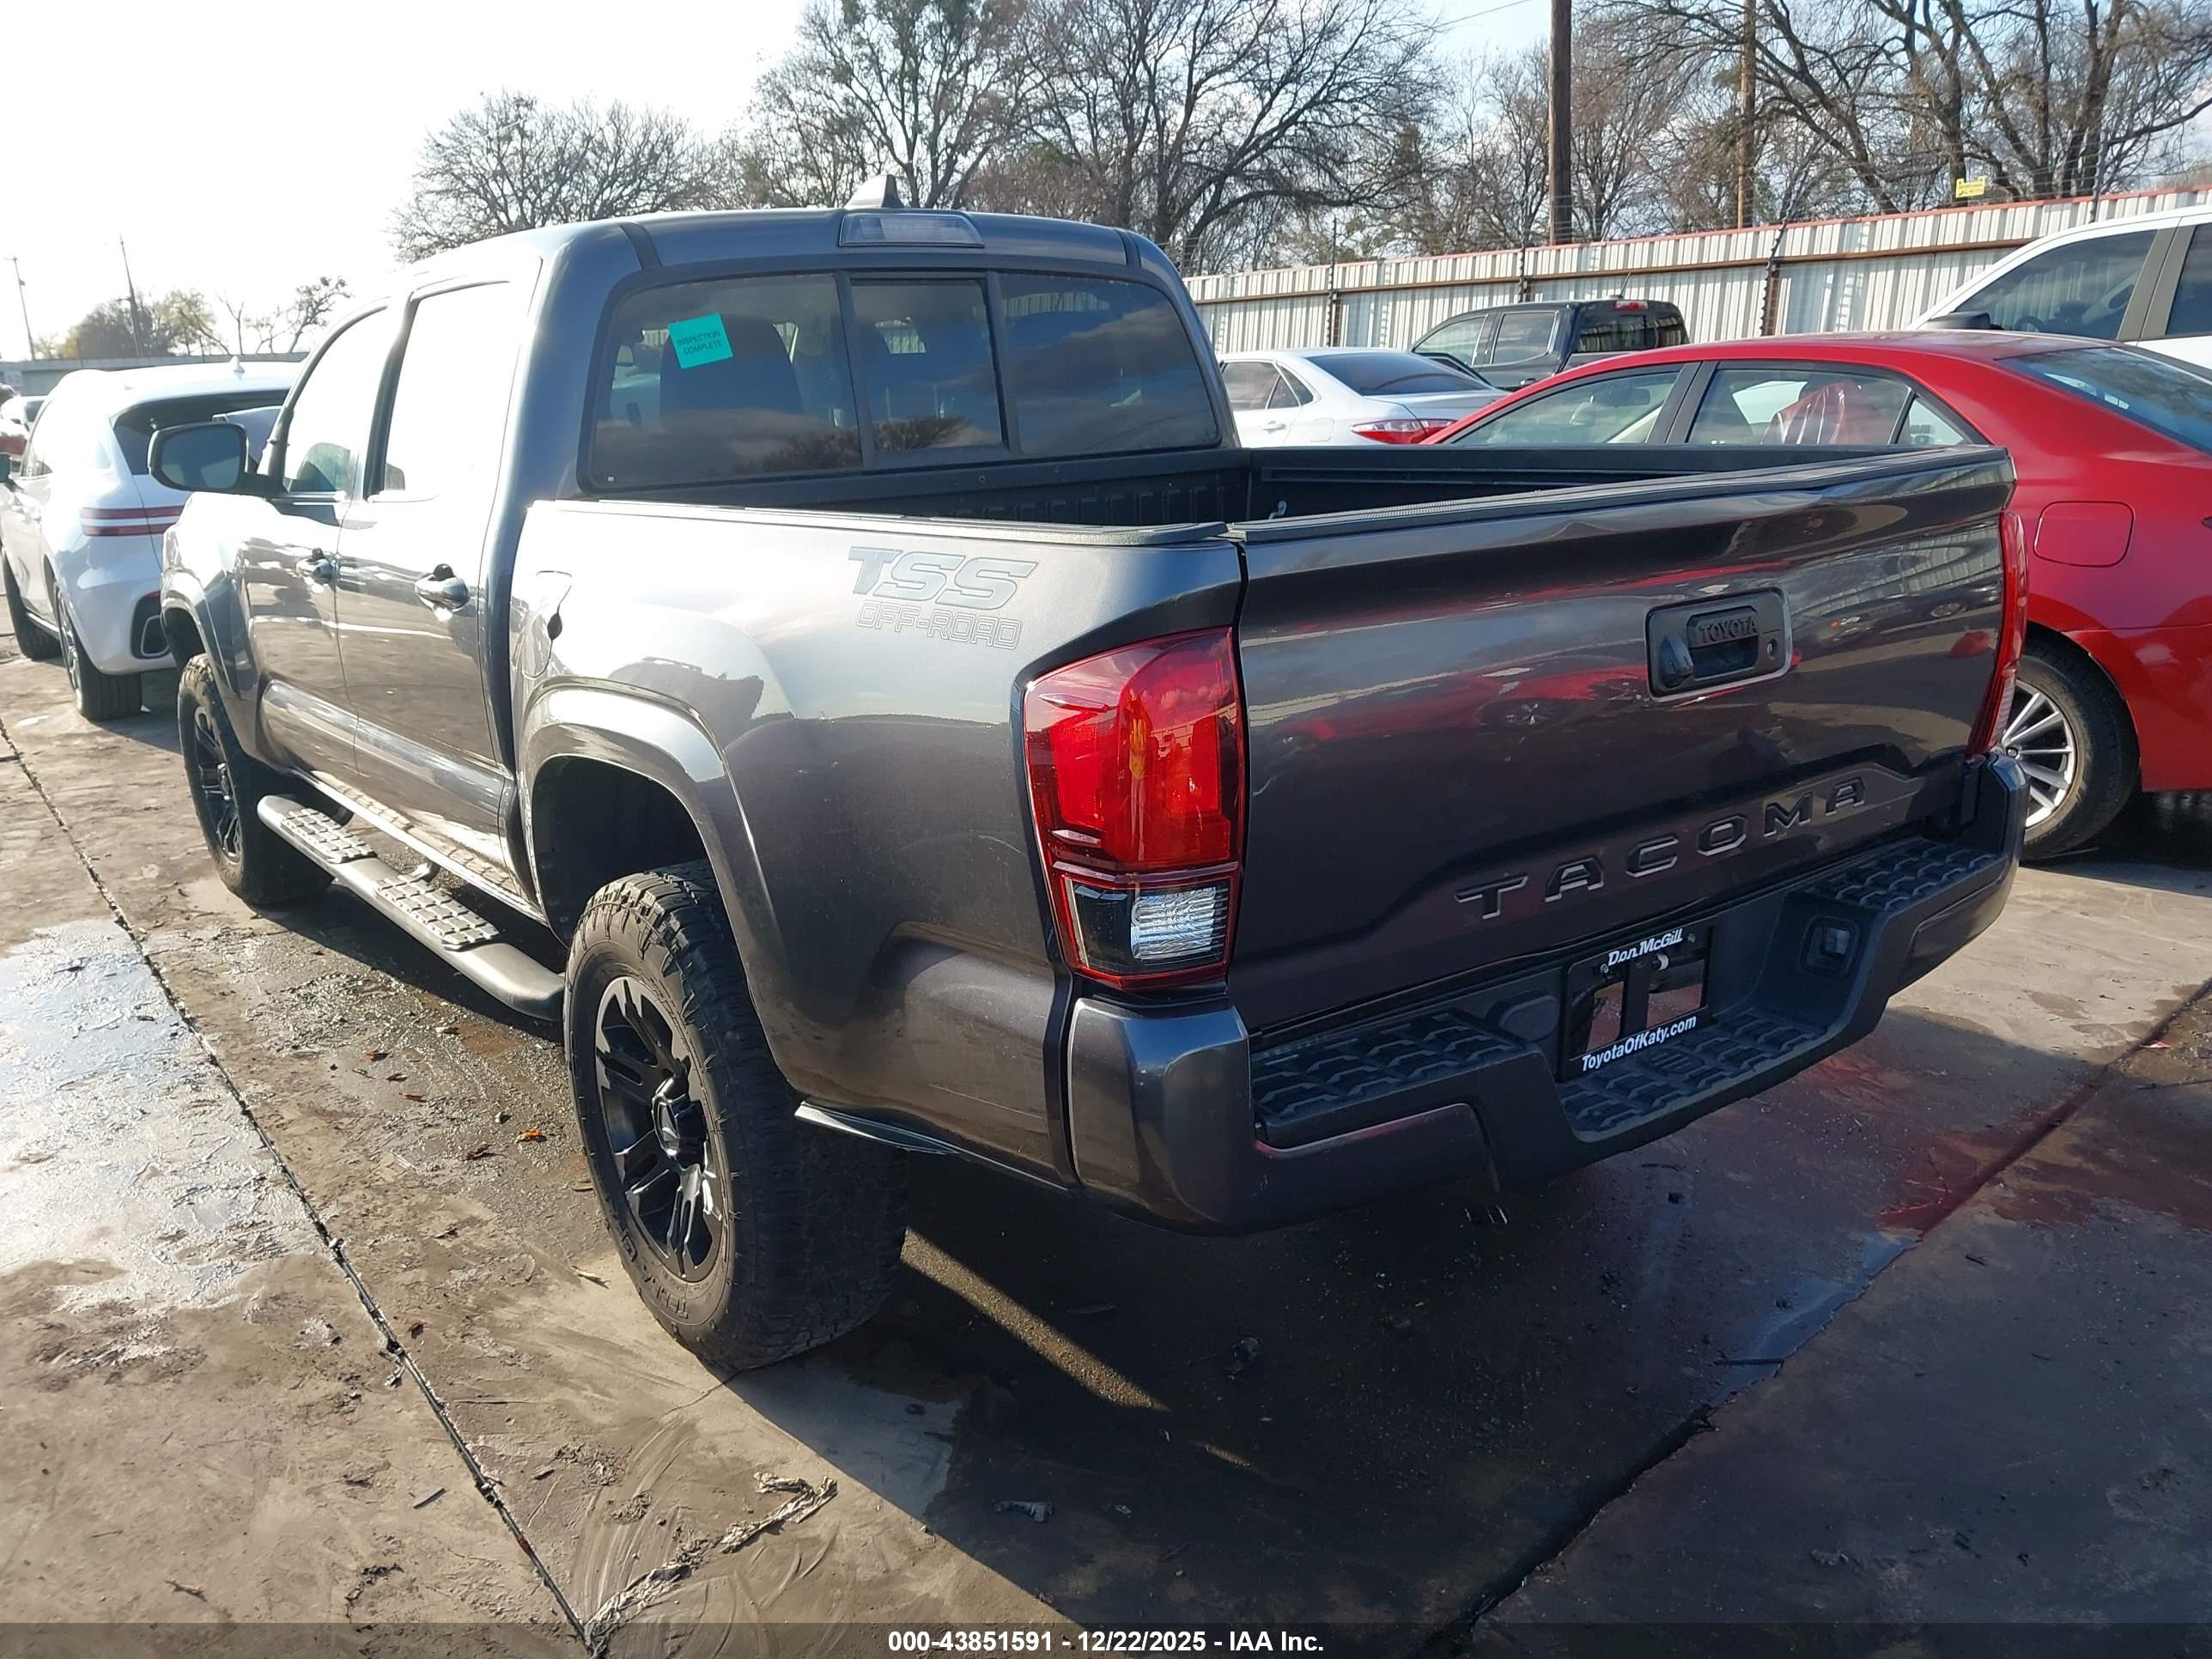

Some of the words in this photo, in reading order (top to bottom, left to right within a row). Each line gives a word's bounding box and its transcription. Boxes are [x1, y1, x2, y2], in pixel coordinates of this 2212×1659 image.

[677, 330, 721, 346] INSPECTION
[684, 340, 722, 355] COMPLETE
[848, 545, 1039, 611] TSS
[856, 600, 1024, 651] OFF-ROAD
[1699, 616, 1758, 643] TOYOTA
[1454, 775, 1867, 921] TACOMA
[1607, 948, 1638, 967] Don
[1638, 927, 1684, 956] McGill
[1582, 1015, 1697, 1073] ToyotaOfKaty.com
